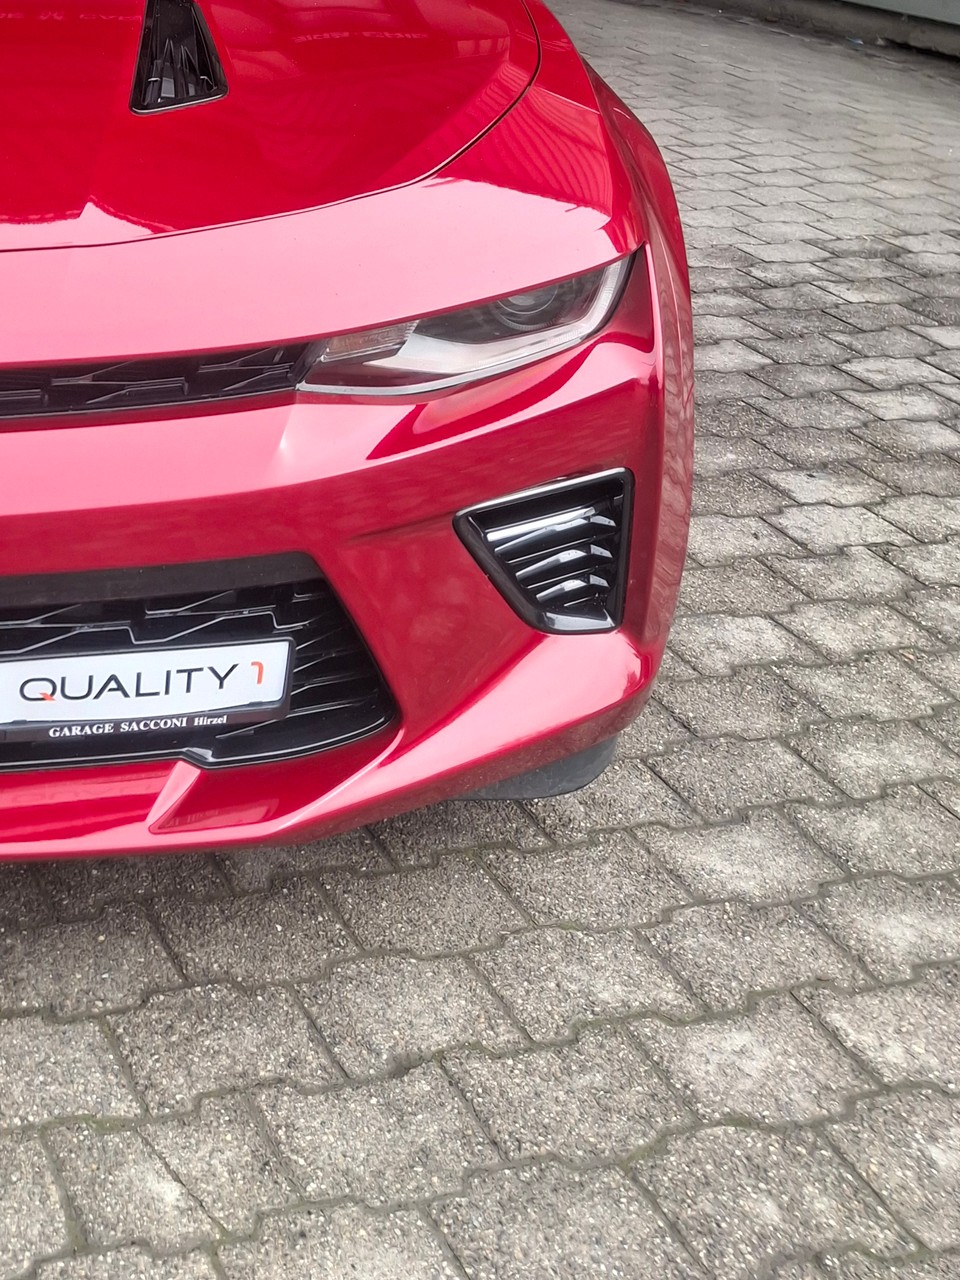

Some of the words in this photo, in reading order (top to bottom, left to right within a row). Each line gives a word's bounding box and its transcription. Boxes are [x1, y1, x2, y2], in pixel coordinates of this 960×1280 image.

[19, 663, 240, 702] QUALITY
[49, 723, 114, 738] GARAGE
[120, 717, 188, 732] SACCONI
[193, 715, 227, 726] Hirzel
